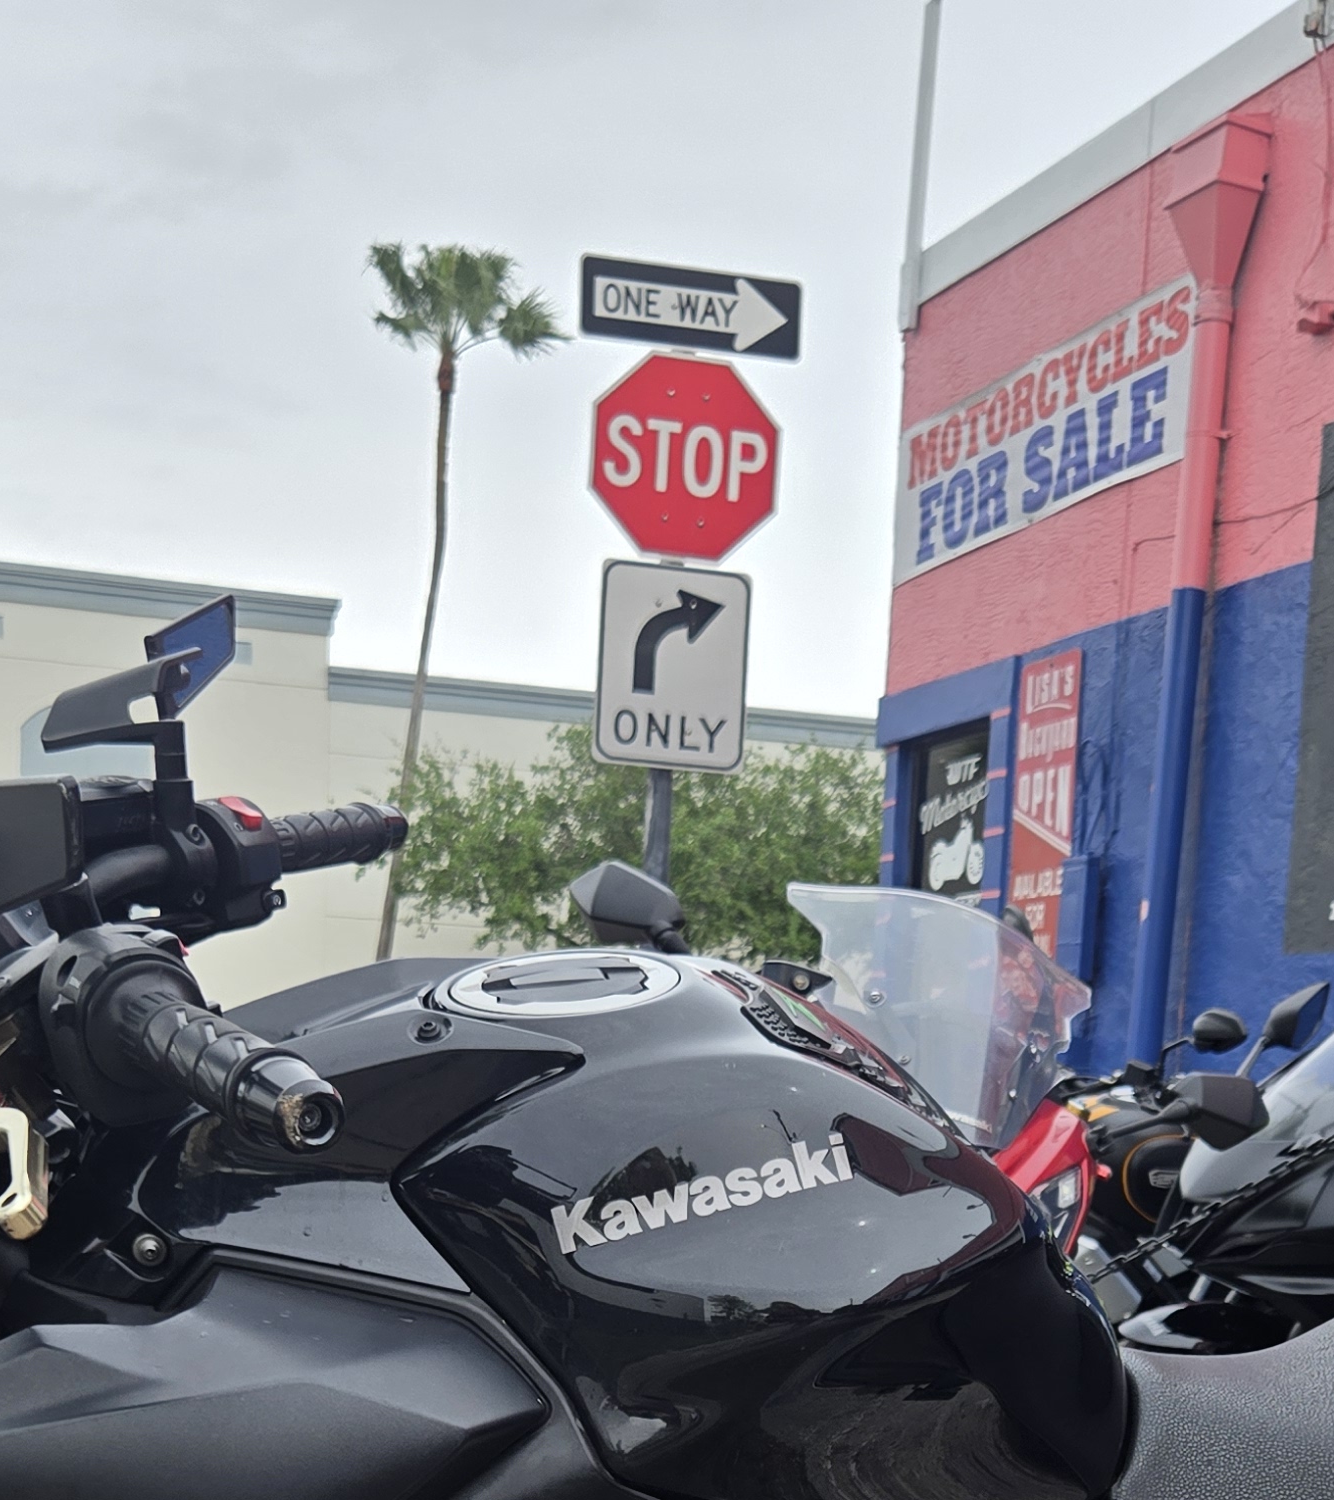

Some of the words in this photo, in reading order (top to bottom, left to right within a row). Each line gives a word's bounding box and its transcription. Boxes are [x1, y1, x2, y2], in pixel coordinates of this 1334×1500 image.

[603, 283, 661, 318] ONE
[677, 292, 739, 328] WAY
[907, 286, 1191, 490] MOTORCYCLES
[602, 414, 767, 503] STOP
[916, 450, 1008, 566] FOR
[1022, 365, 1169, 514] SALE
[614, 708, 727, 754] ONLY
[1017, 764, 1071, 838] OPEN
[550, 1134, 855, 1256] Kawasaki
